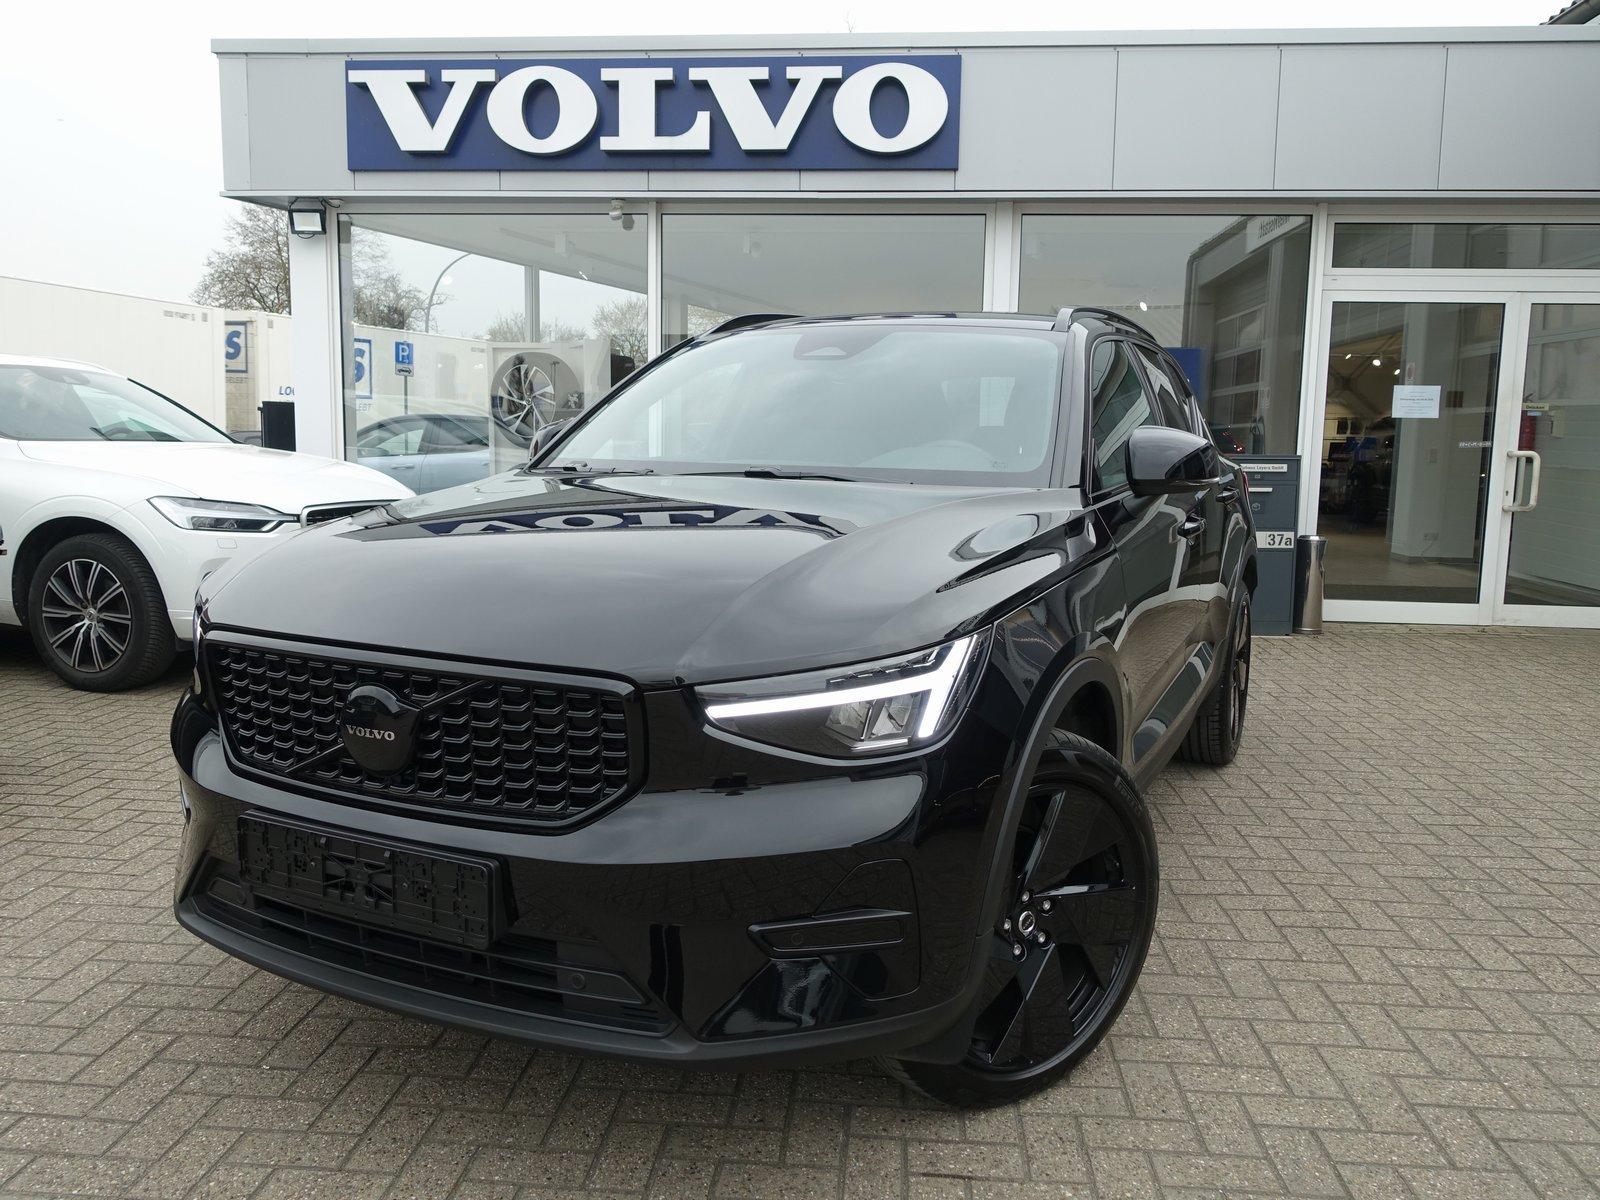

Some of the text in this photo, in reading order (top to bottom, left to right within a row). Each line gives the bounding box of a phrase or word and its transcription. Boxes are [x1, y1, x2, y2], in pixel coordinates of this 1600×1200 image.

[347, 62, 949, 155] VOLVO
[399, 345, 410, 362] P
[279, 385, 295, 396] LO
[1267, 533, 1293, 547] 37a
[345, 724, 396, 741] VOLVO
